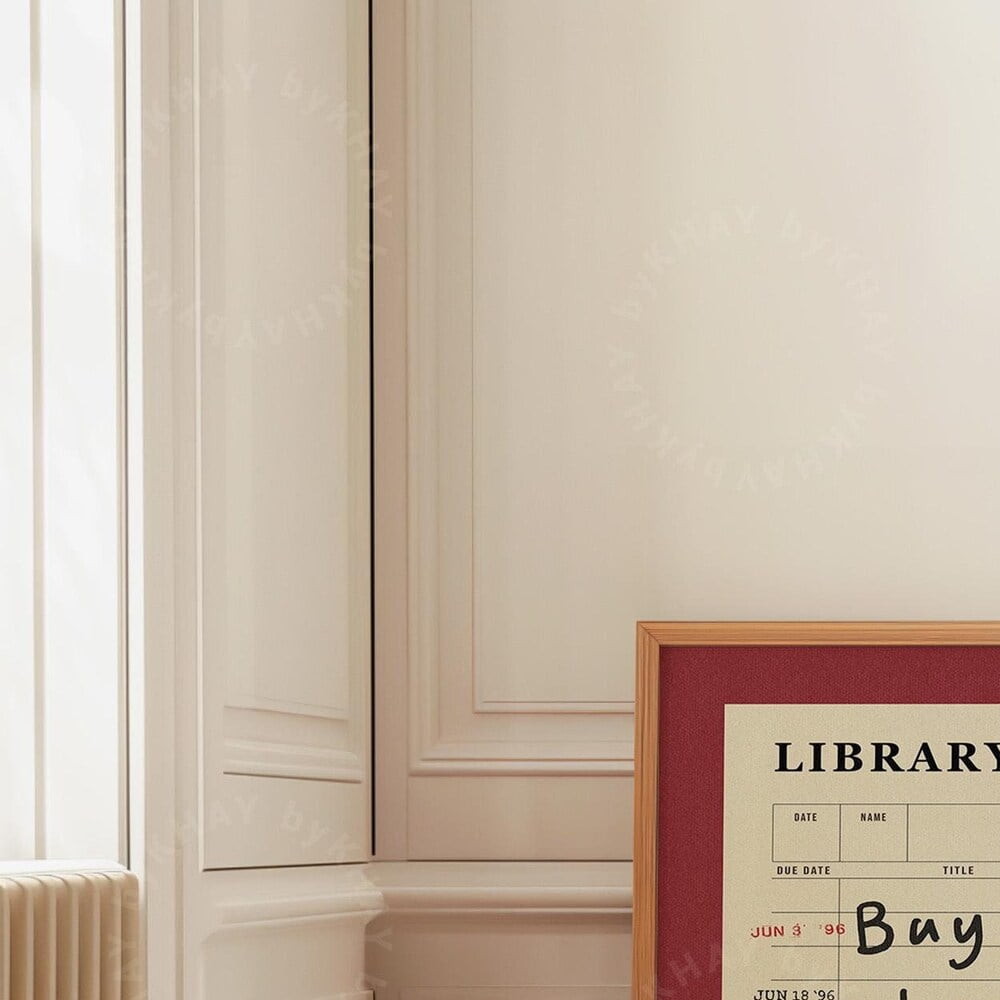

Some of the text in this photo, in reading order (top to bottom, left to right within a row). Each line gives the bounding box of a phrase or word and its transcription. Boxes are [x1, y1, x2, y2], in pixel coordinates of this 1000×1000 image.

[794, 812, 818, 822] DATE
[860, 812, 887, 822] NAME
[777, 866, 831, 875] DUE DATE
[943, 866, 974, 875] TITLE
[750, 925, 785, 938] JUN
[856, 900, 983, 970] Buy
